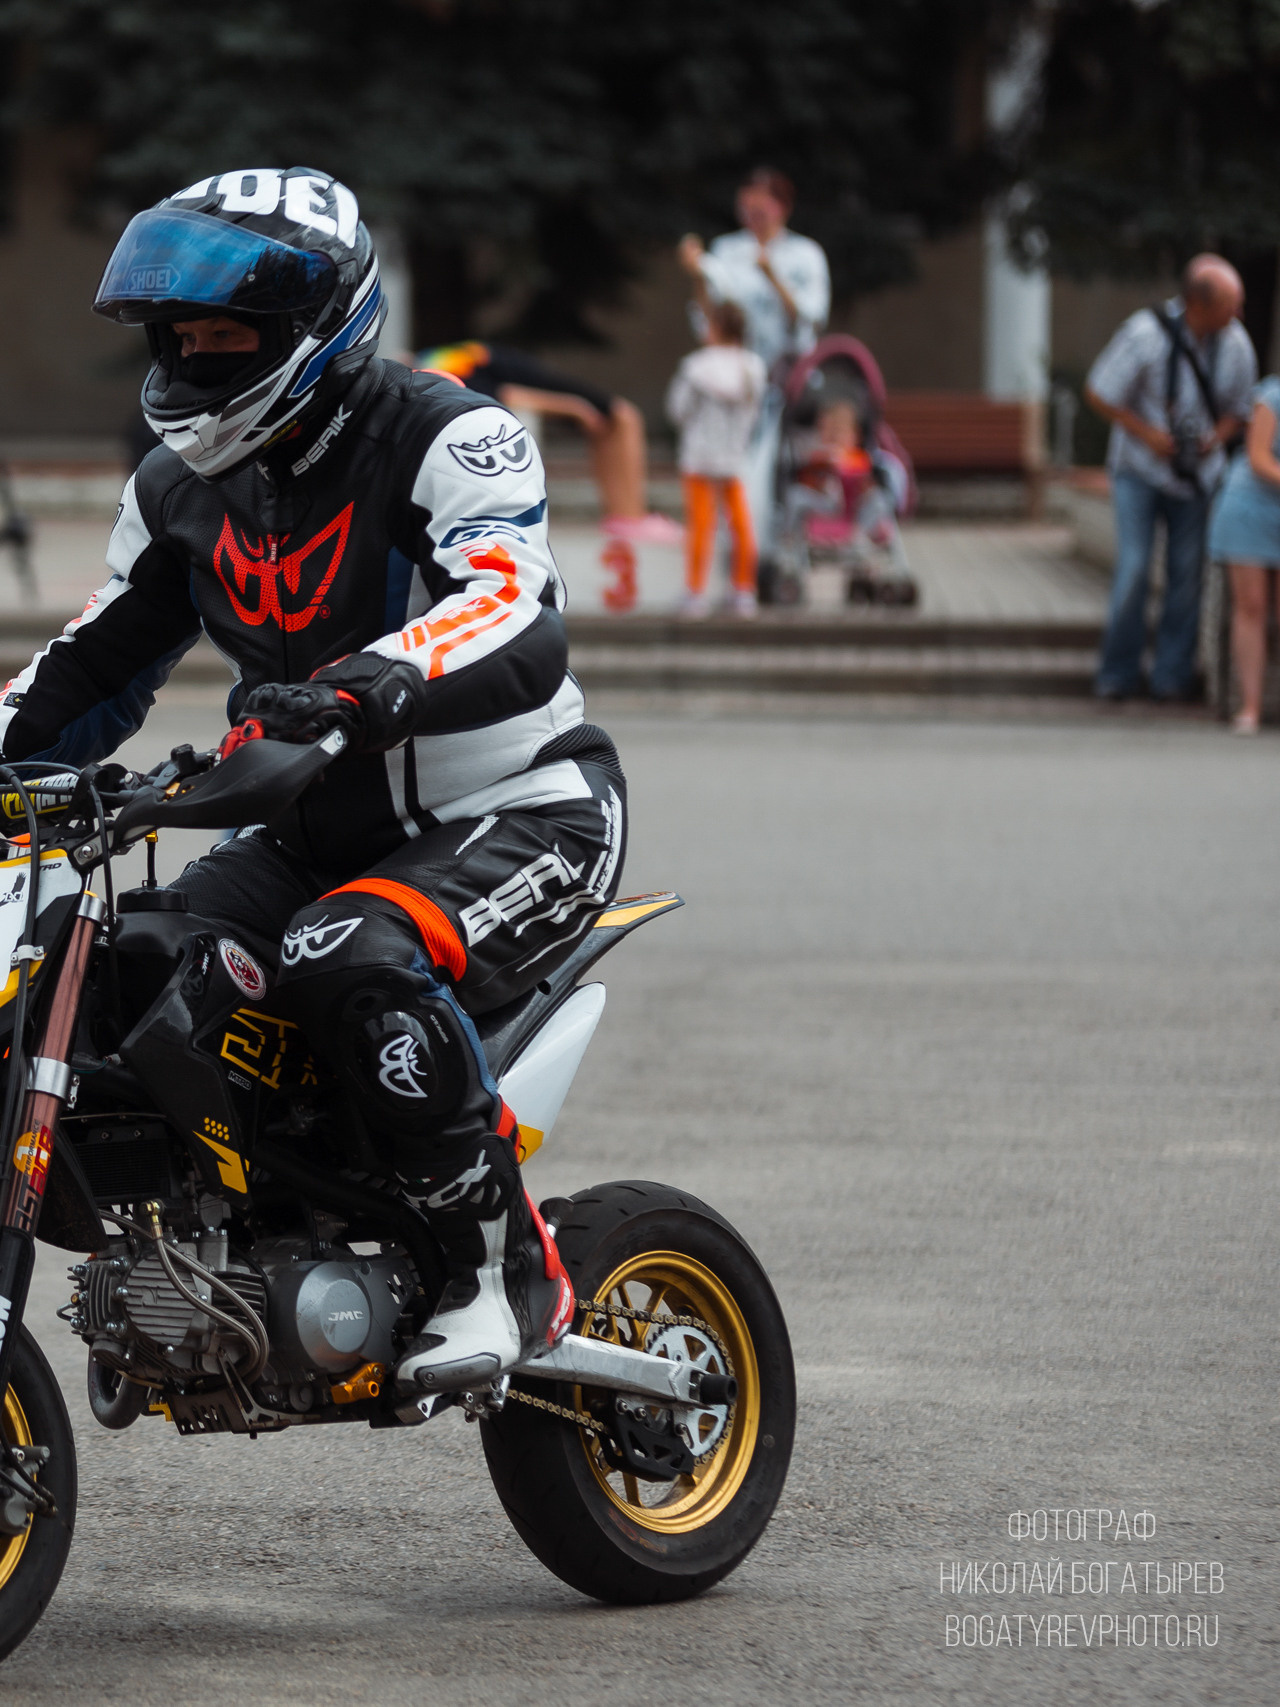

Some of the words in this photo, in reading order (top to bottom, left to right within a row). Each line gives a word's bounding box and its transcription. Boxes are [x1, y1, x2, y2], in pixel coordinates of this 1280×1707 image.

[131, 269, 171, 290] SHOEI
[291, 403, 353, 477] BERIK
[328, 1310, 365, 1322] JMC
